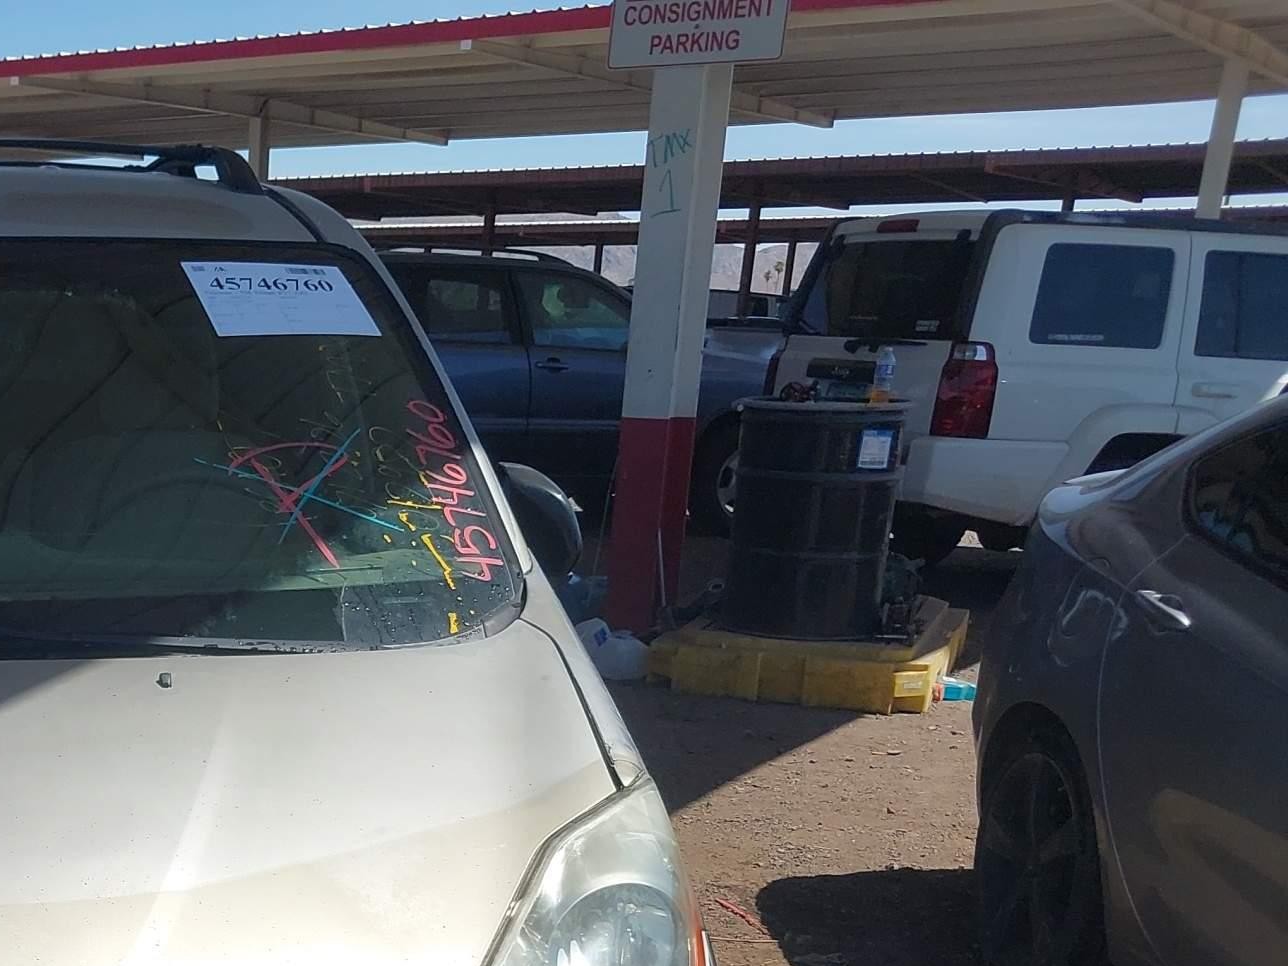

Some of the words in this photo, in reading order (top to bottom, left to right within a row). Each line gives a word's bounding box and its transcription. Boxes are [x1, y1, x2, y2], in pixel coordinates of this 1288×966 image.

[623, 0, 772, 26] CONSIGNMENT
[649, 29, 740, 55] PARKING
[209, 276, 334, 293] 45746760
[408, 399, 504, 582] 45746760
